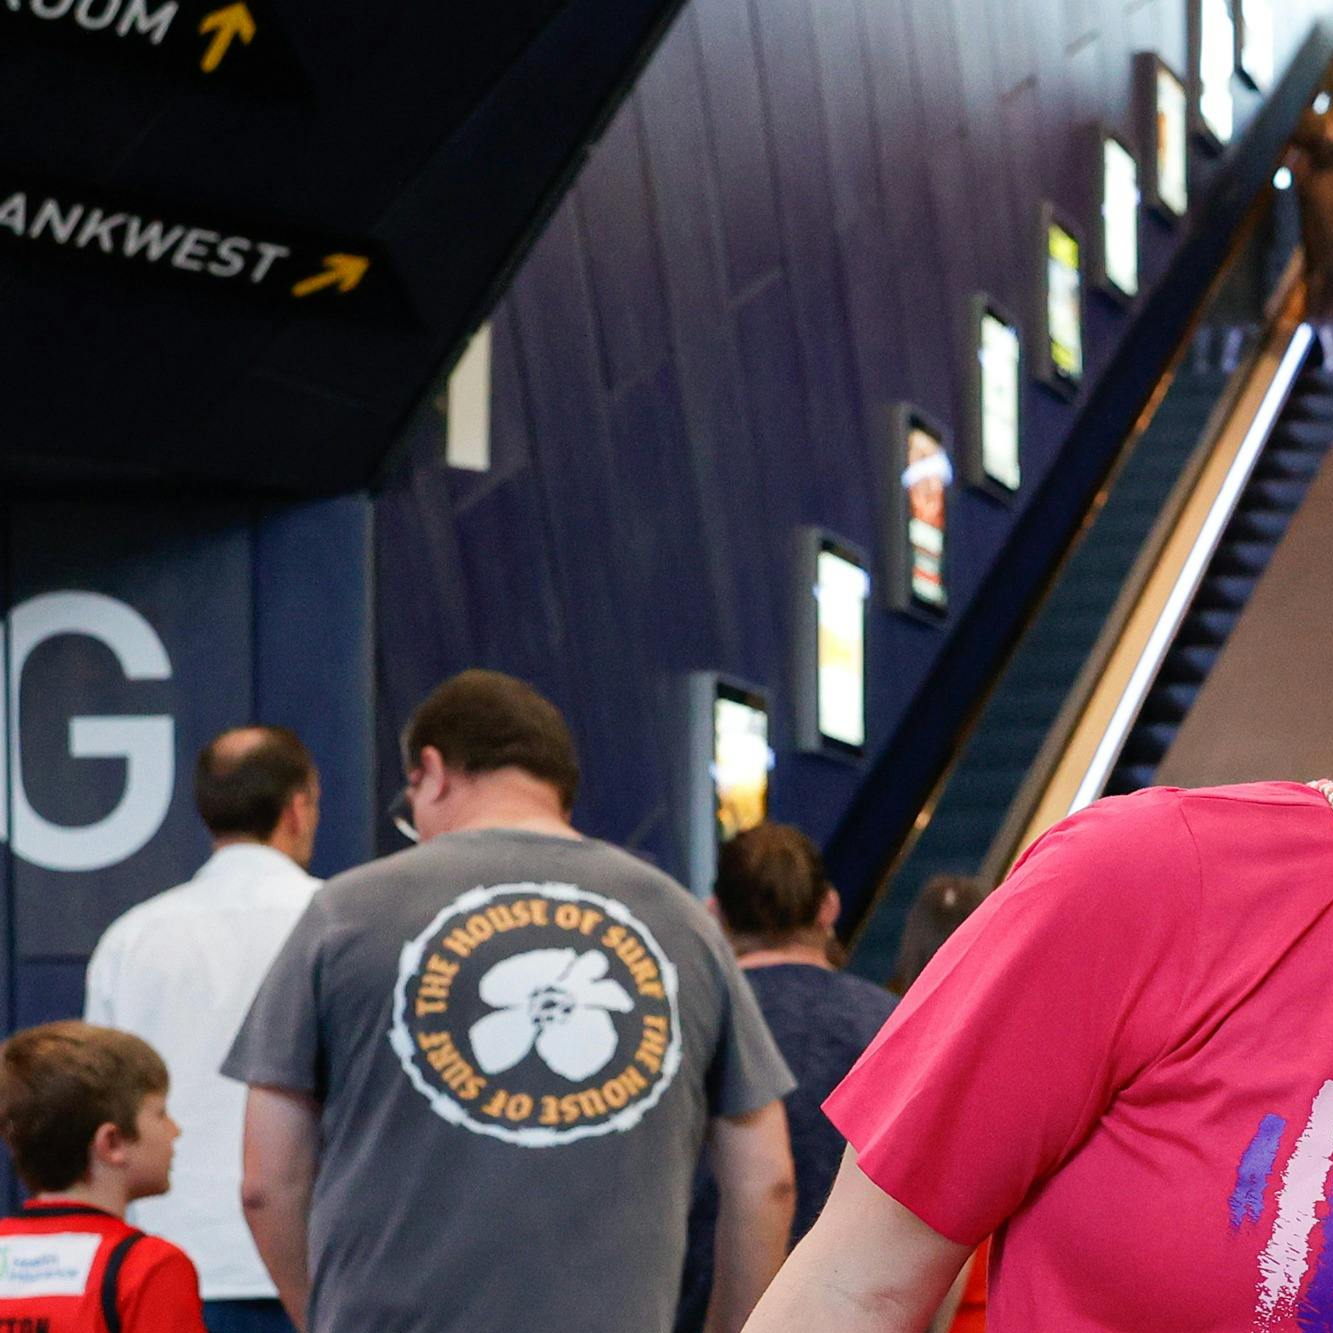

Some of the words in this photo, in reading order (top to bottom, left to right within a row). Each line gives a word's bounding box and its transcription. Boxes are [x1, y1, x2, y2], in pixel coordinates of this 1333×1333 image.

[5, 0, 179, 45] OM
[0, 589, 175, 872] G
[415, 953, 460, 1017] THE
[634, 1015, 668, 1074] THE
[481, 1090, 534, 1122] OF
